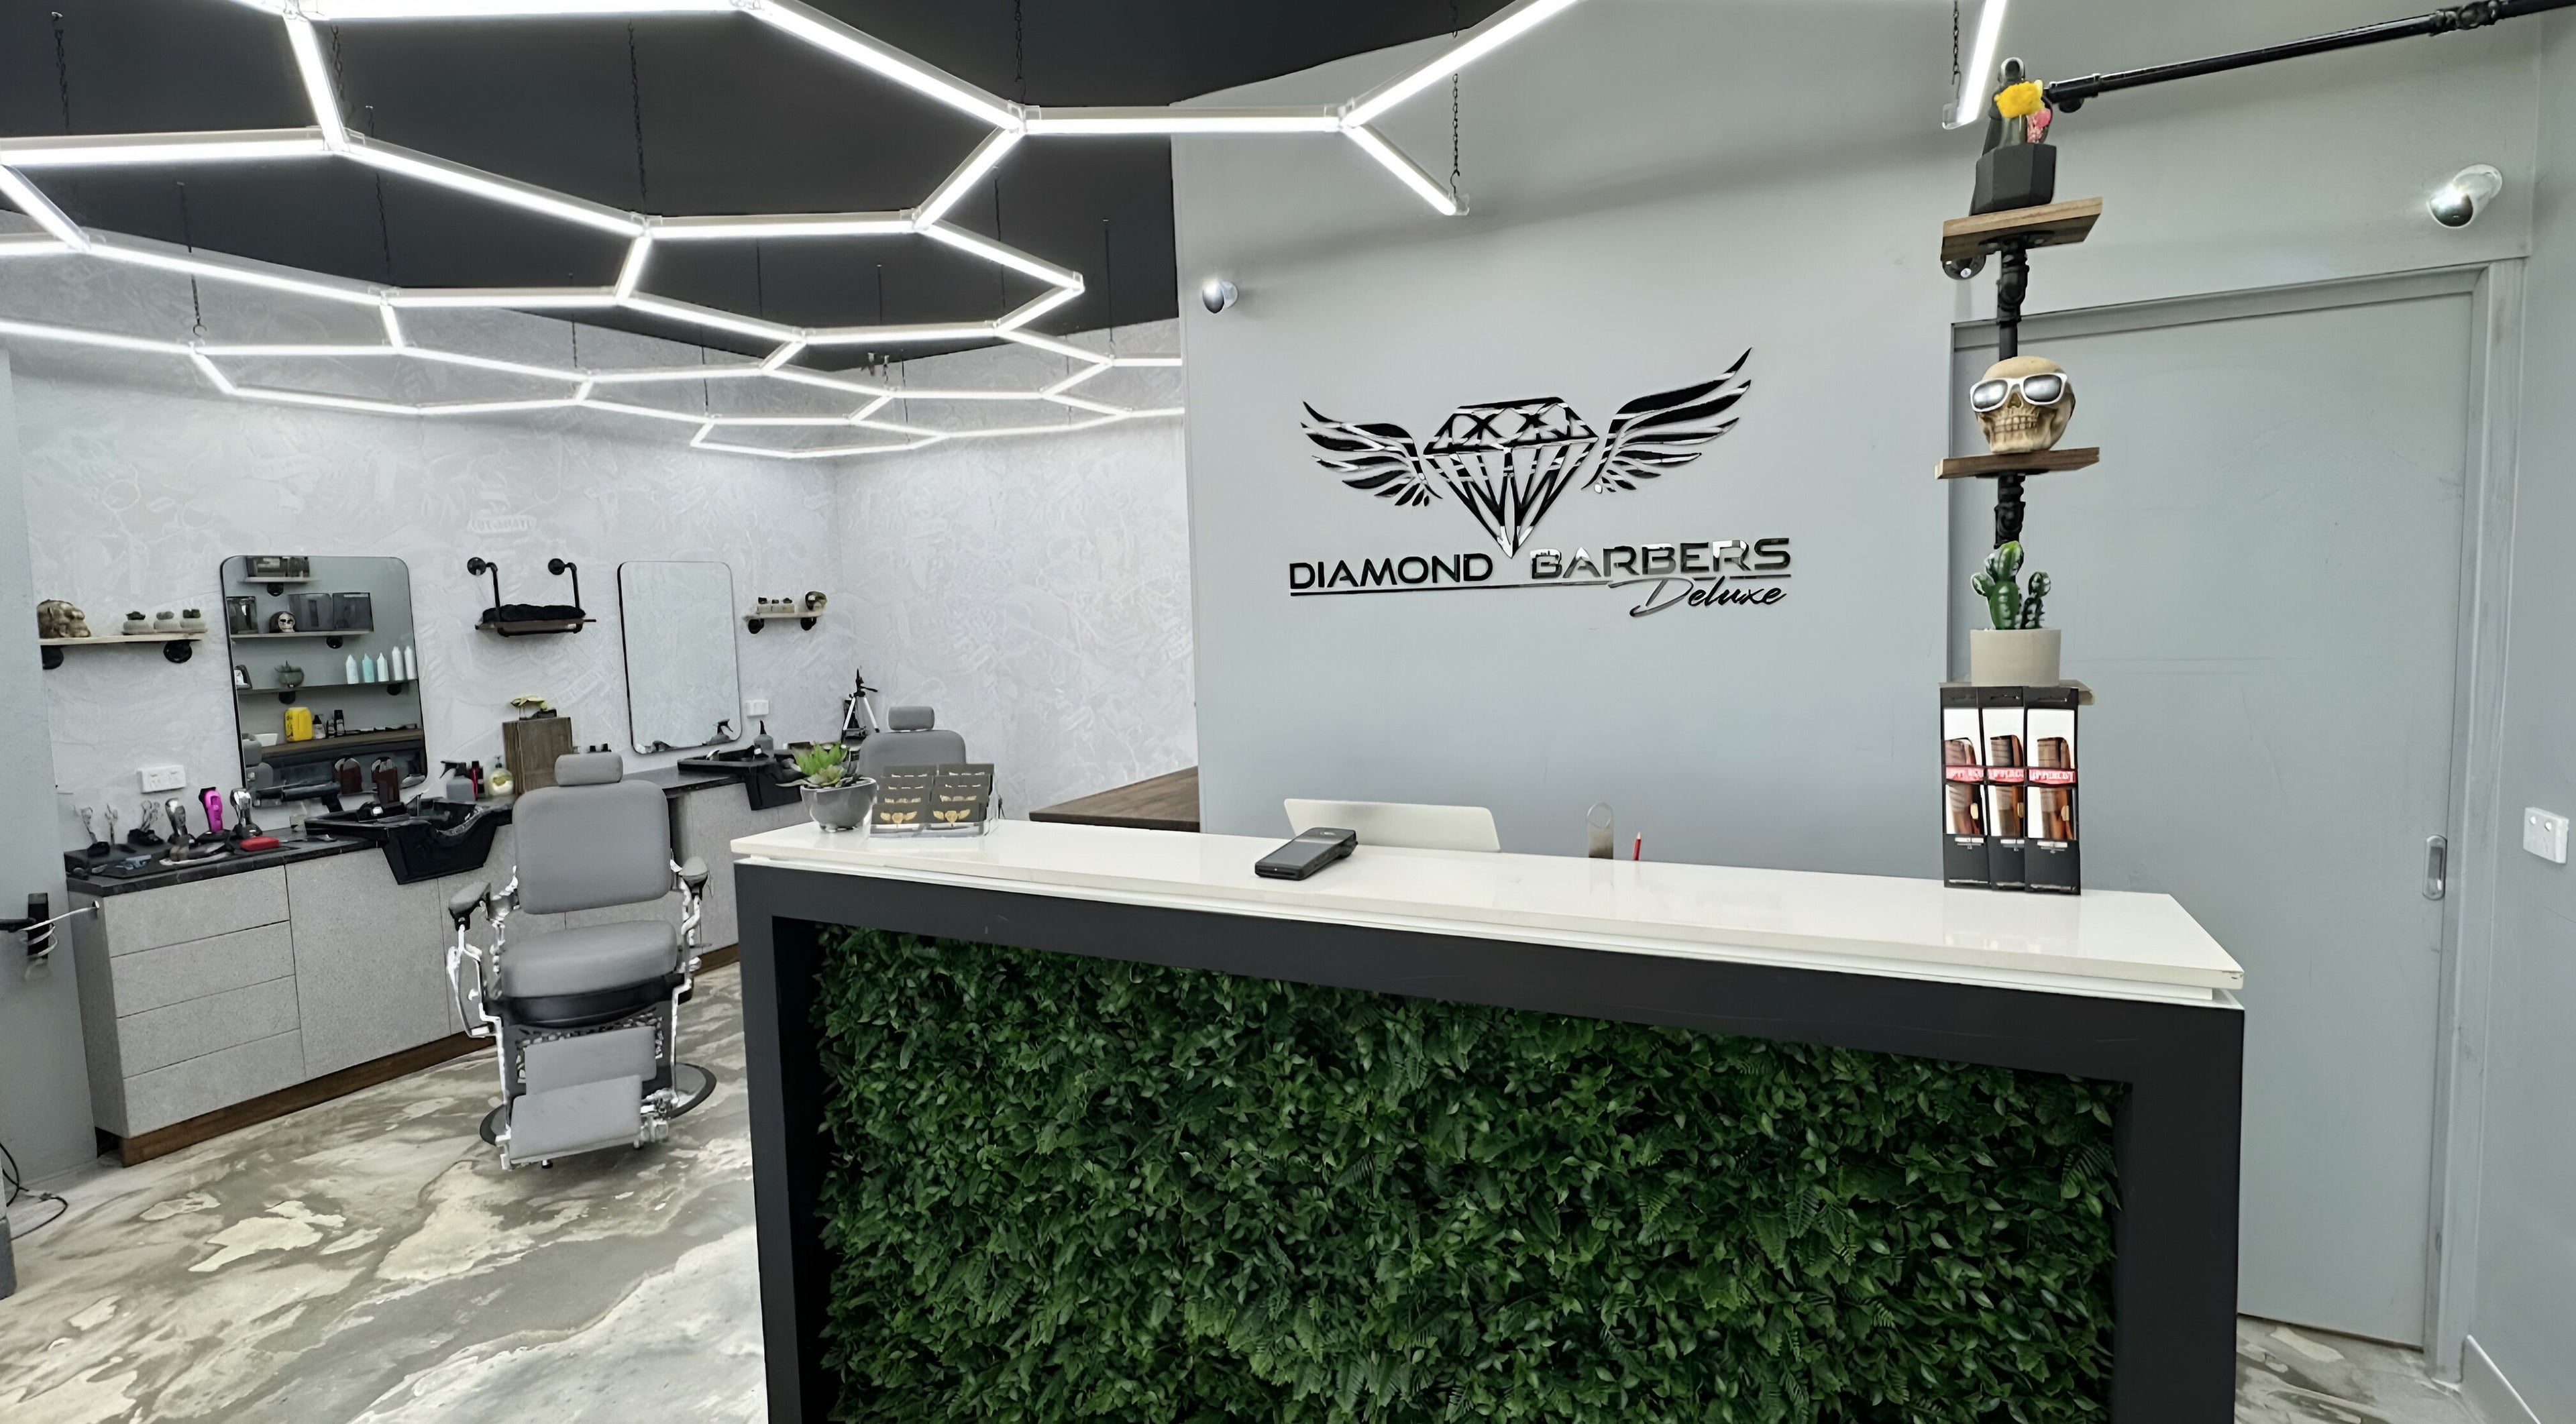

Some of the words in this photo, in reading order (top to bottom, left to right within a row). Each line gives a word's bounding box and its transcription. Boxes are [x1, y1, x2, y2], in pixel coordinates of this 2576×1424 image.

[1289, 553, 1494, 590] DIAMOND
[1529, 537, 1792, 580] BARBERS
[1608, 575, 1787, 618] Deluxe
